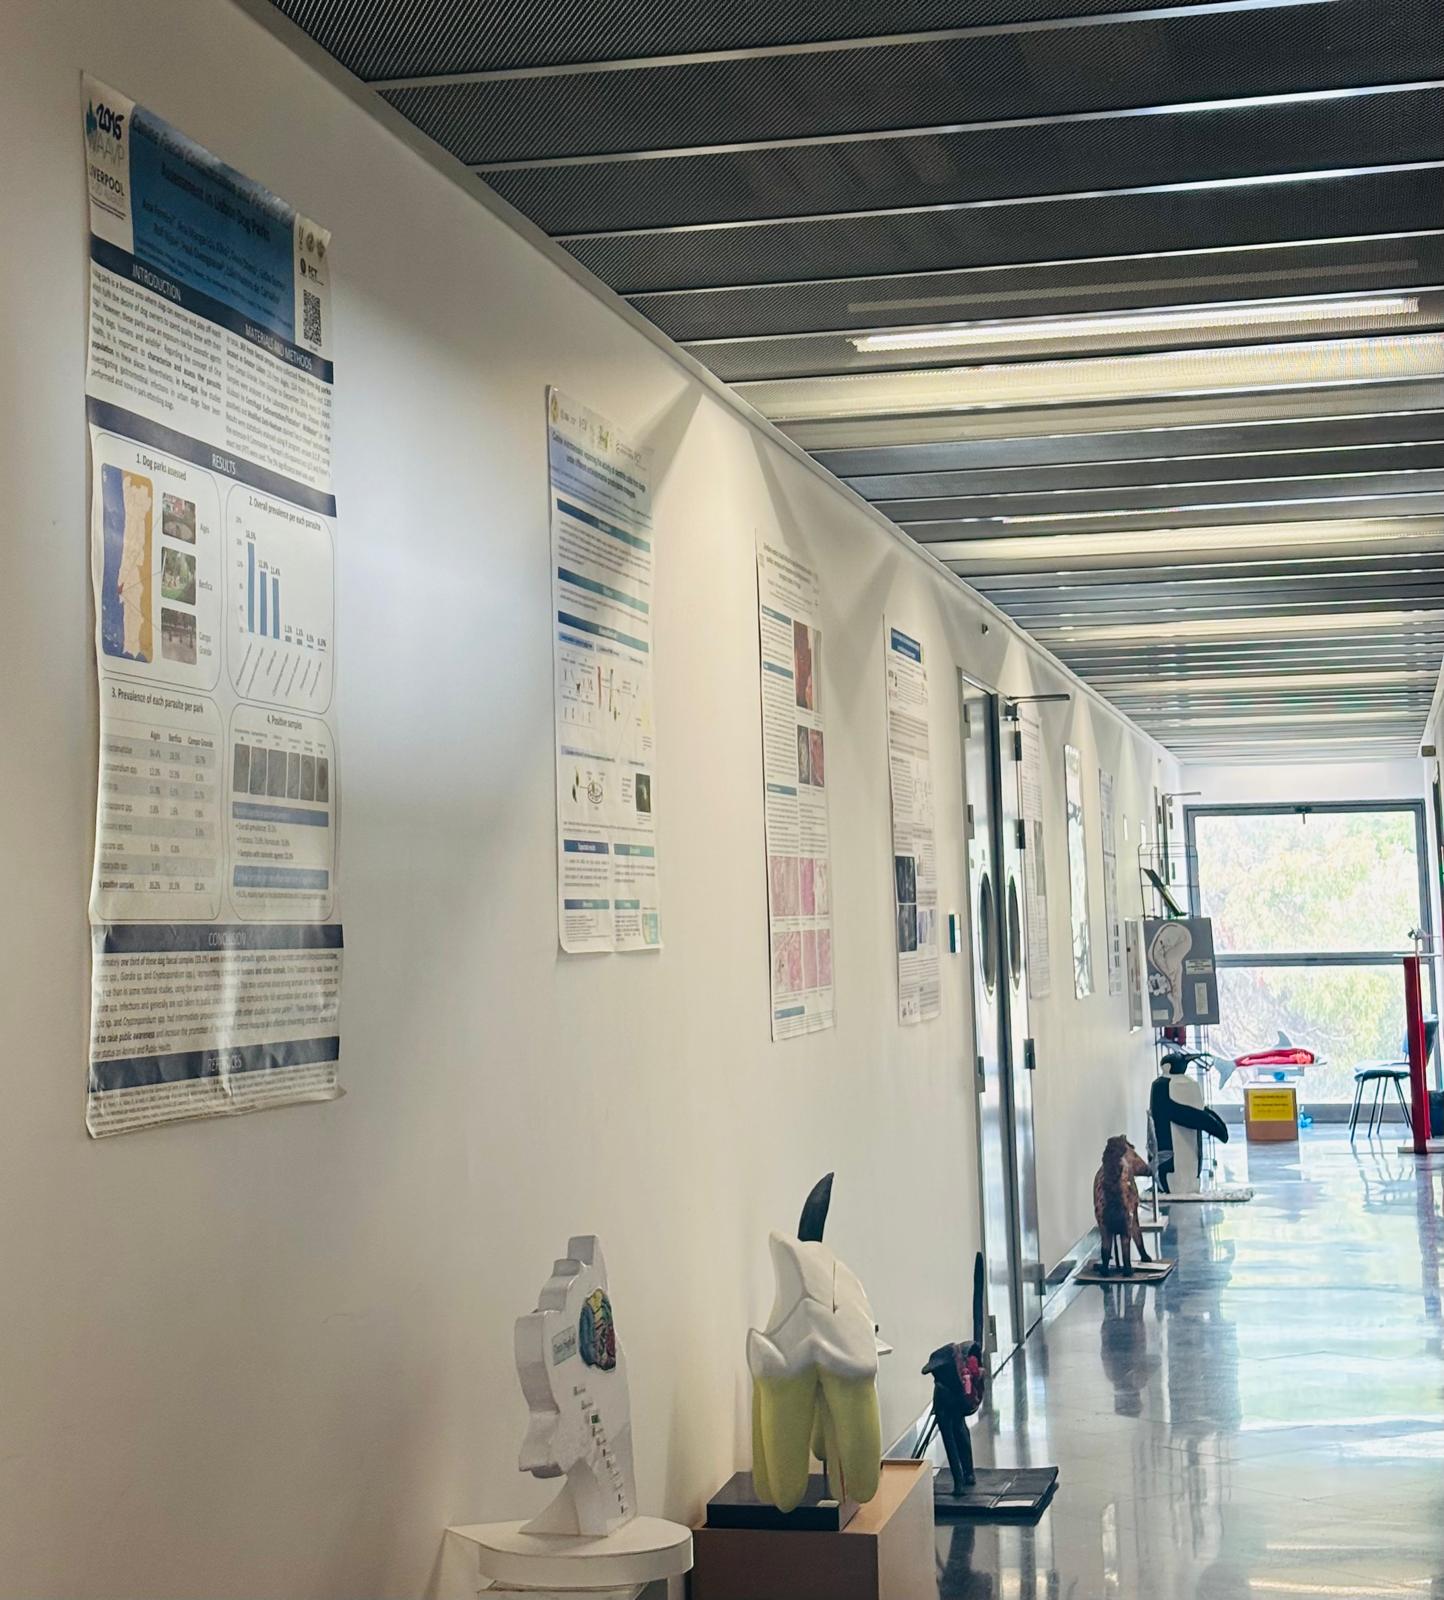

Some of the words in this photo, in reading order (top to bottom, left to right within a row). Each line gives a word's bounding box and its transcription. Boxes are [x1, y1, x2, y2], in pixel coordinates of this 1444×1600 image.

[132, 264, 182, 302] INTRODUCTION
[143, 455, 154, 470] Dog
[211, 452, 237, 476] RESULTS
[118, 689, 146, 704] Prevalence
[207, 1055, 243, 1072] REFCES
